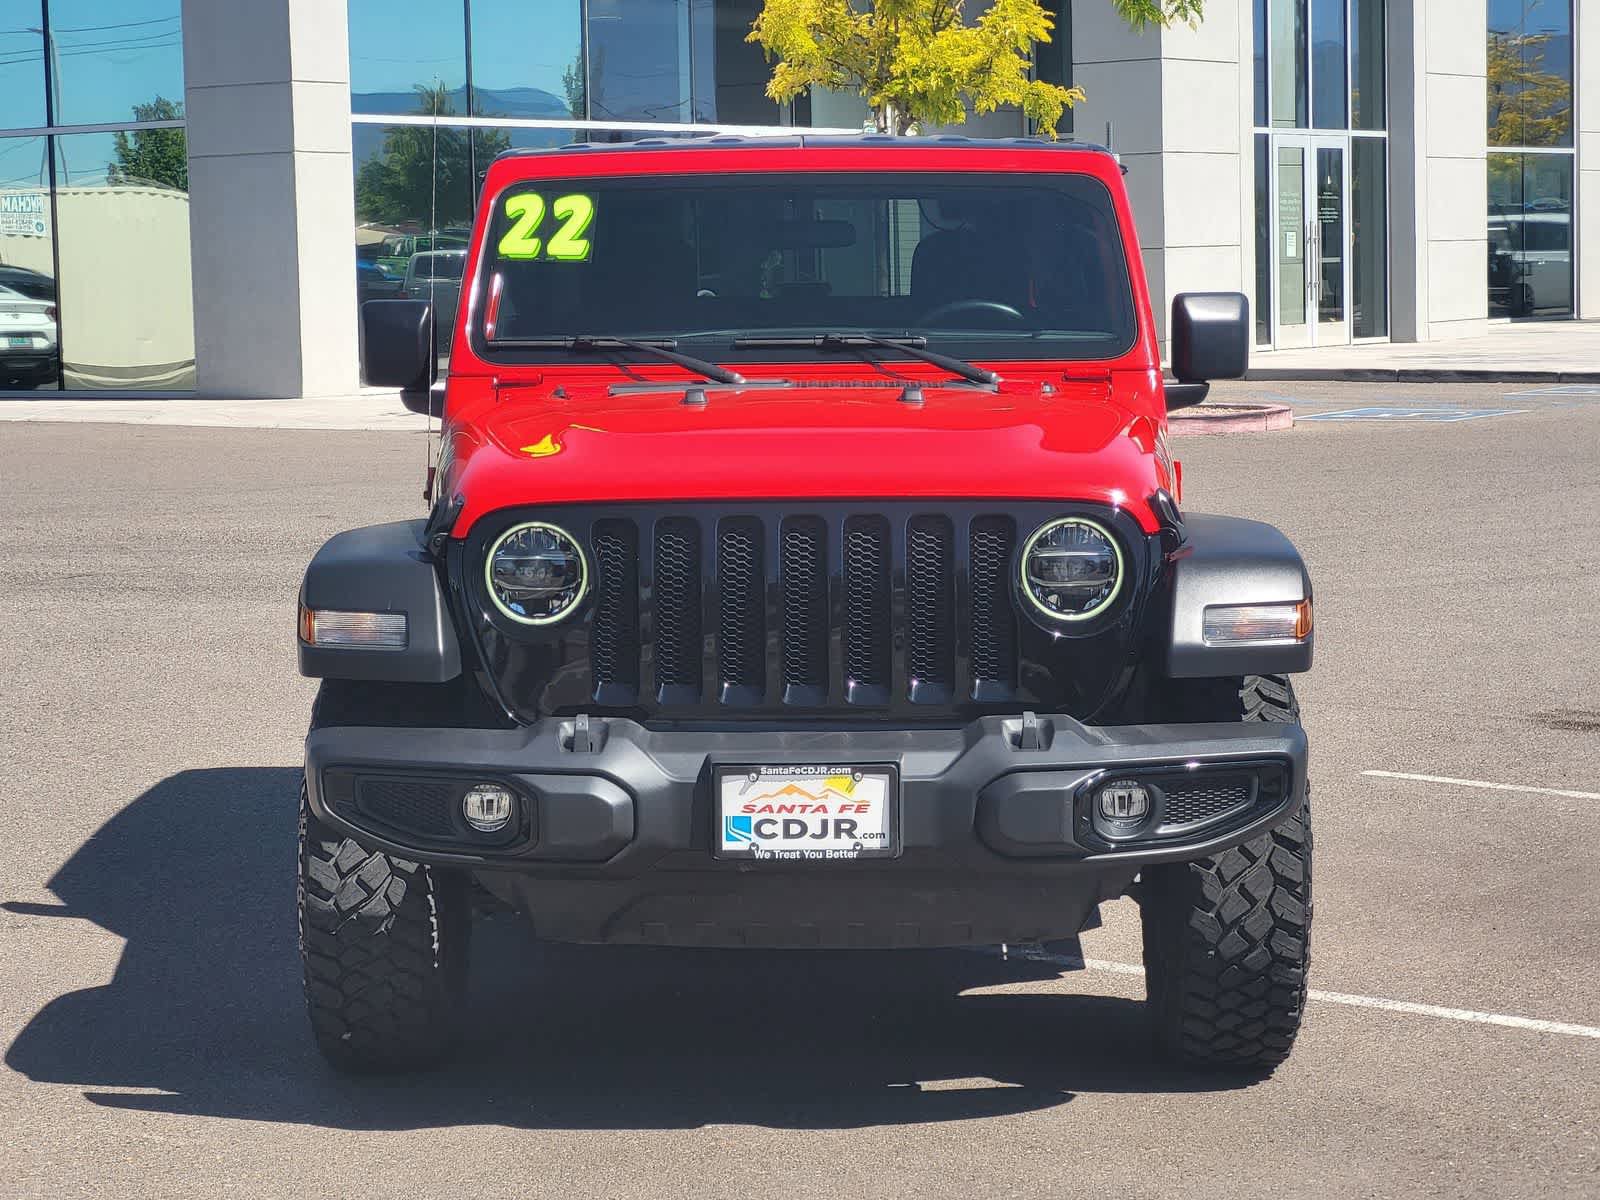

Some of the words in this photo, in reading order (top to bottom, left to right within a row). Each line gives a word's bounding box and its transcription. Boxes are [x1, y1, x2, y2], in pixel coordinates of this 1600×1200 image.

[498, 192, 594, 260] 22
[760, 767, 852, 775] SantaFeCDJR.com
[741, 804, 828, 814] SANTA
[754, 850, 771, 859] We
[774, 850, 800, 859] Treat
[803, 850, 825, 859] You
[827, 850, 858, 859] Better
